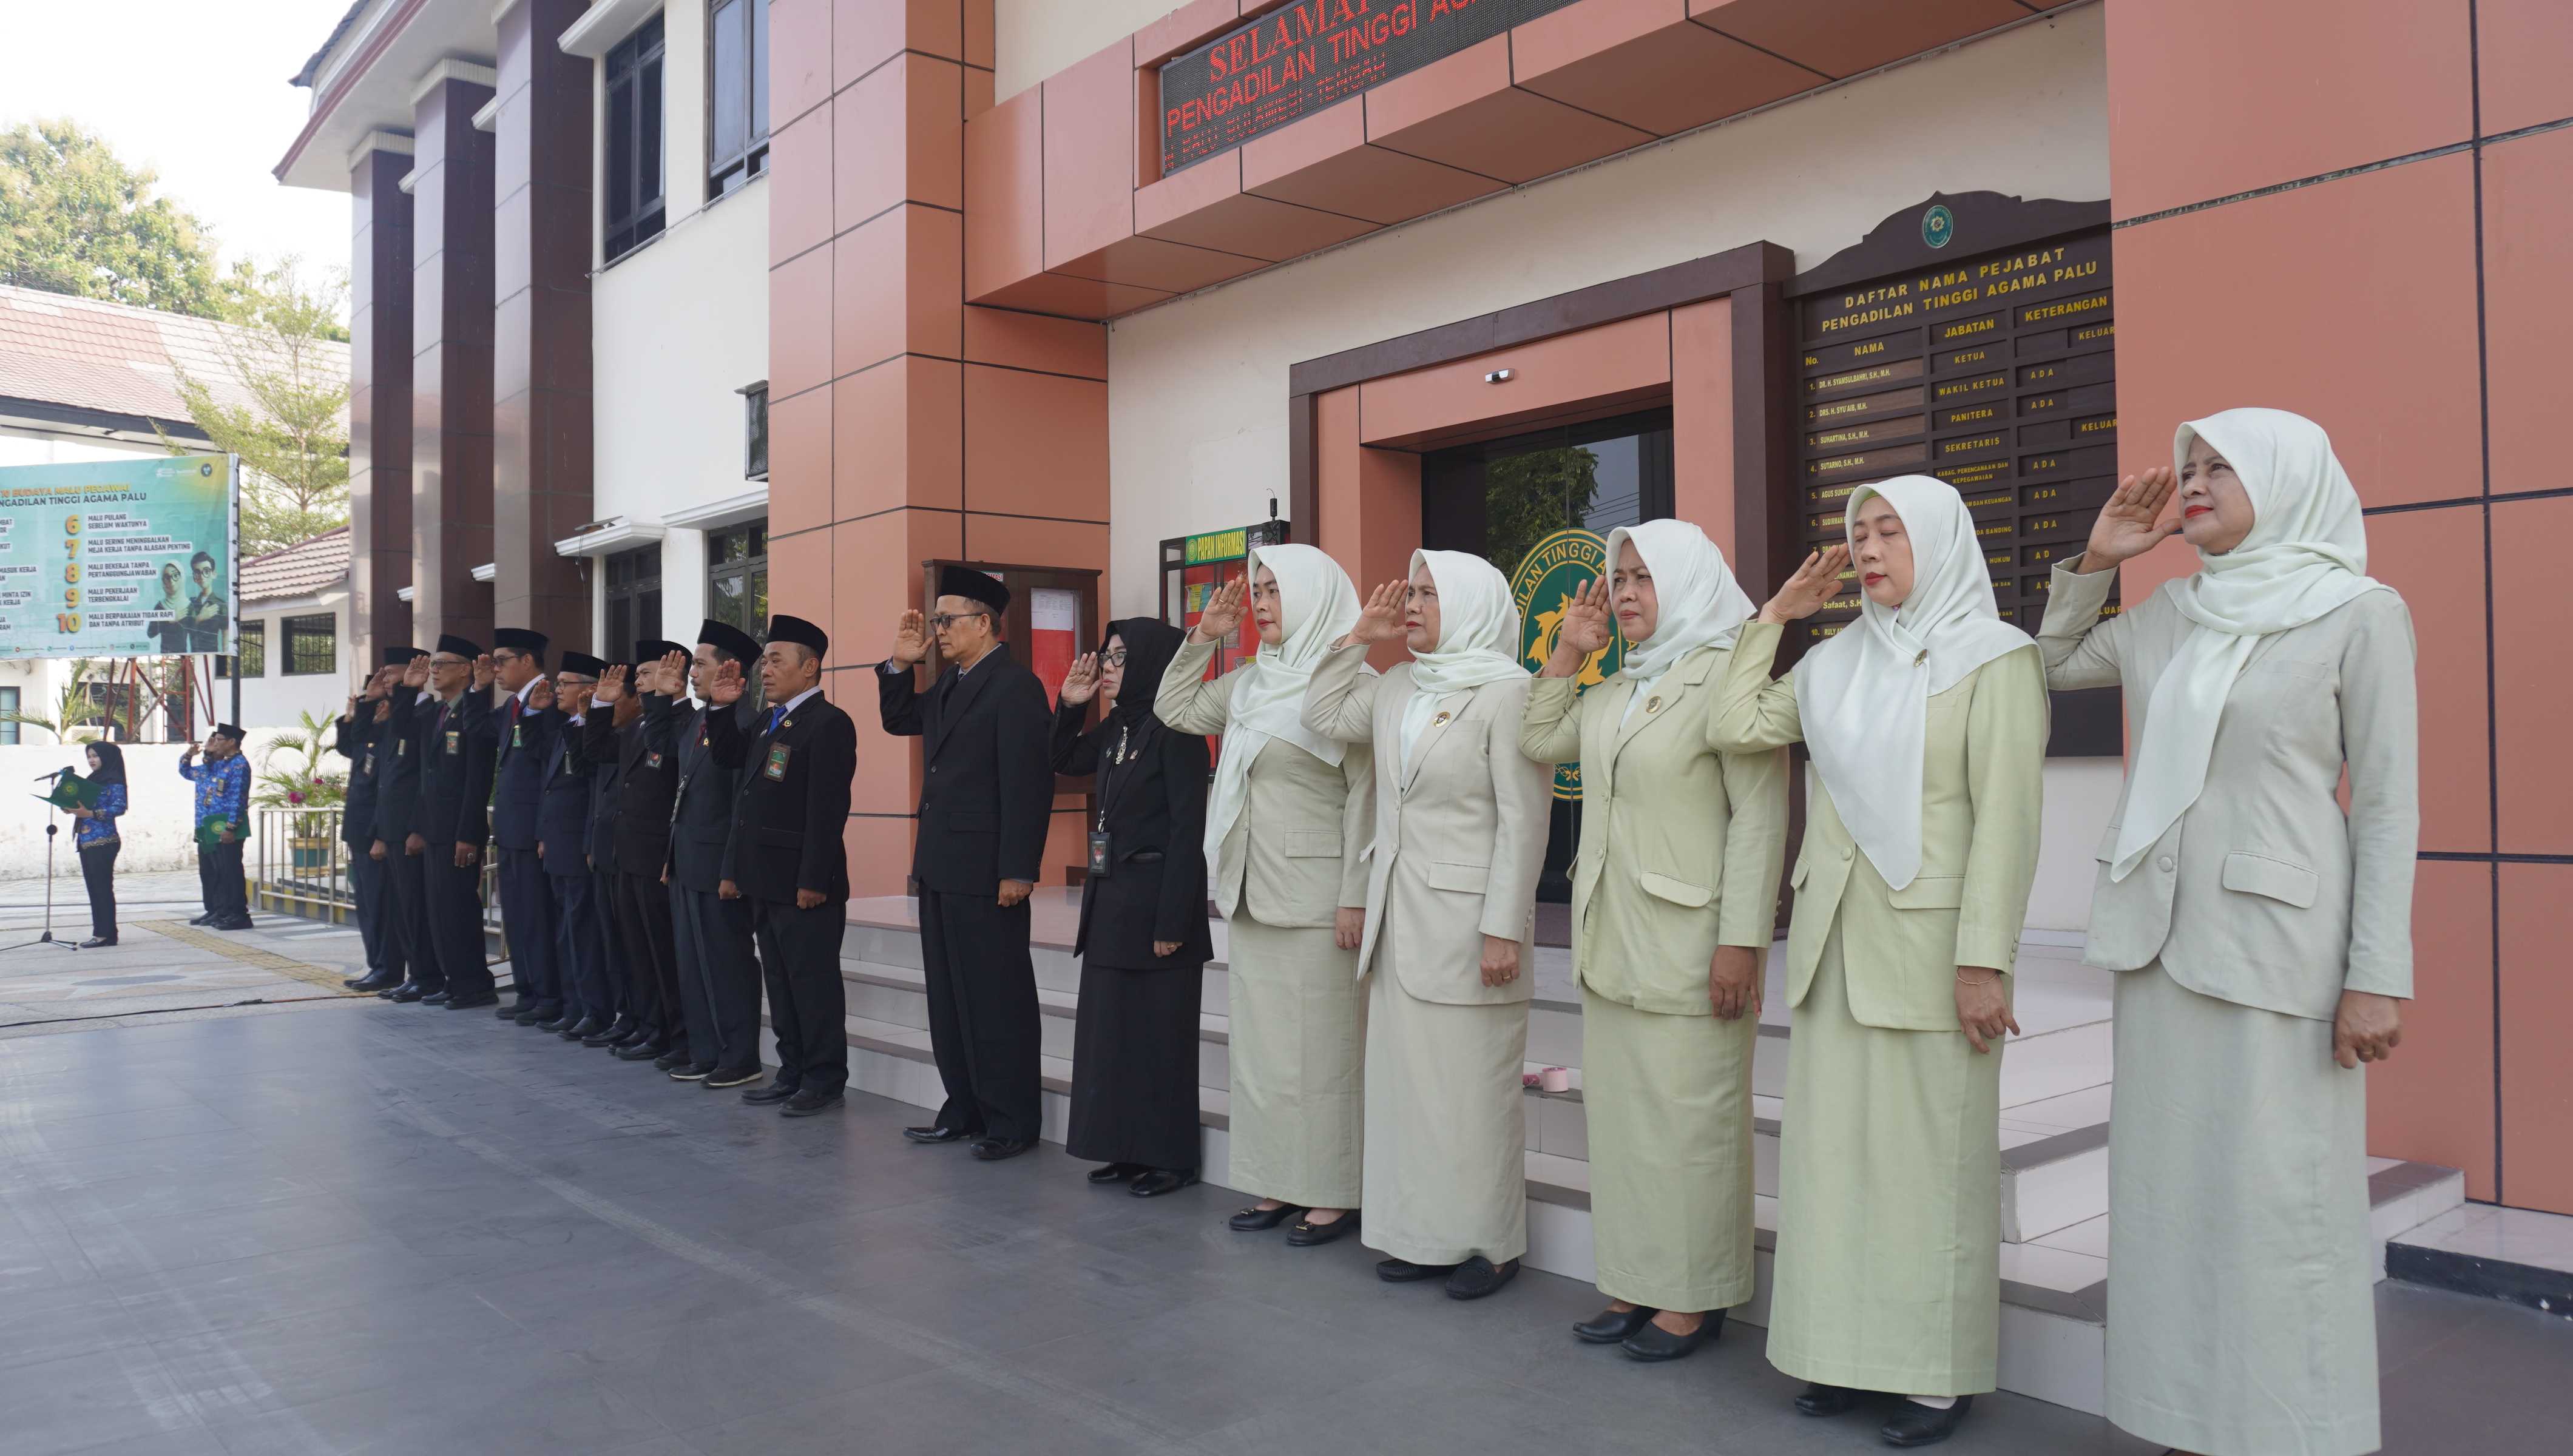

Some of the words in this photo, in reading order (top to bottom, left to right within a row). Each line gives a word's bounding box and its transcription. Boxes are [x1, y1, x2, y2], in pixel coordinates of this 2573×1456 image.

[1166, 45, 1316, 138] PENGADILAN
[1327, 0, 1417, 63] TINGGI
[1845, 284, 1909, 308] DAFTAR
[1919, 271, 1969, 292] NAMA
[1980, 248, 2066, 278] PEJABAT
[1822, 303, 1914, 332] PENGADILAN
[1924, 288, 1978, 311] TINGGI
[1987, 272, 2047, 297] AGAMA
[2054, 261, 2098, 281] PALU
[2025, 296, 2108, 322] KETERANGAN
[1945, 319, 1995, 339] JABATAN
[1855, 342, 1884, 356] NAMA
[1955, 351, 1985, 364] KETUA
[1805, 356, 1819, 366] No.
[1939, 385, 1969, 396] WAKIL
[1973, 377, 2005, 390] KETUA
[1951, 408, 1993, 423] PANITERA
[1945, 437, 2000, 453] SEKRETARIS
[1953, 474, 1993, 484] KEPEGAWAIAN
[49, 495, 80, 505] TINGGI
[84, 494, 118, 504] AGAMA
[121, 493, 147, 502] PALU
[1821, 490, 1834, 499] AGUS
[66, 514, 81, 534] 6
[1986, 525, 2012, 535] BANDING
[65, 539, 81, 559] 7
[1197, 535, 1214, 561] PAPAN
[1215, 530, 1246, 558] INFORMASI
[1542, 542, 1598, 567] TINGGI
[66, 563, 81, 583] 8
[66, 588, 81, 608] 9
[1823, 600, 1848, 609] Safaat,
[57, 613, 81, 633] 10
[1824, 627, 1836, 636] RULY
